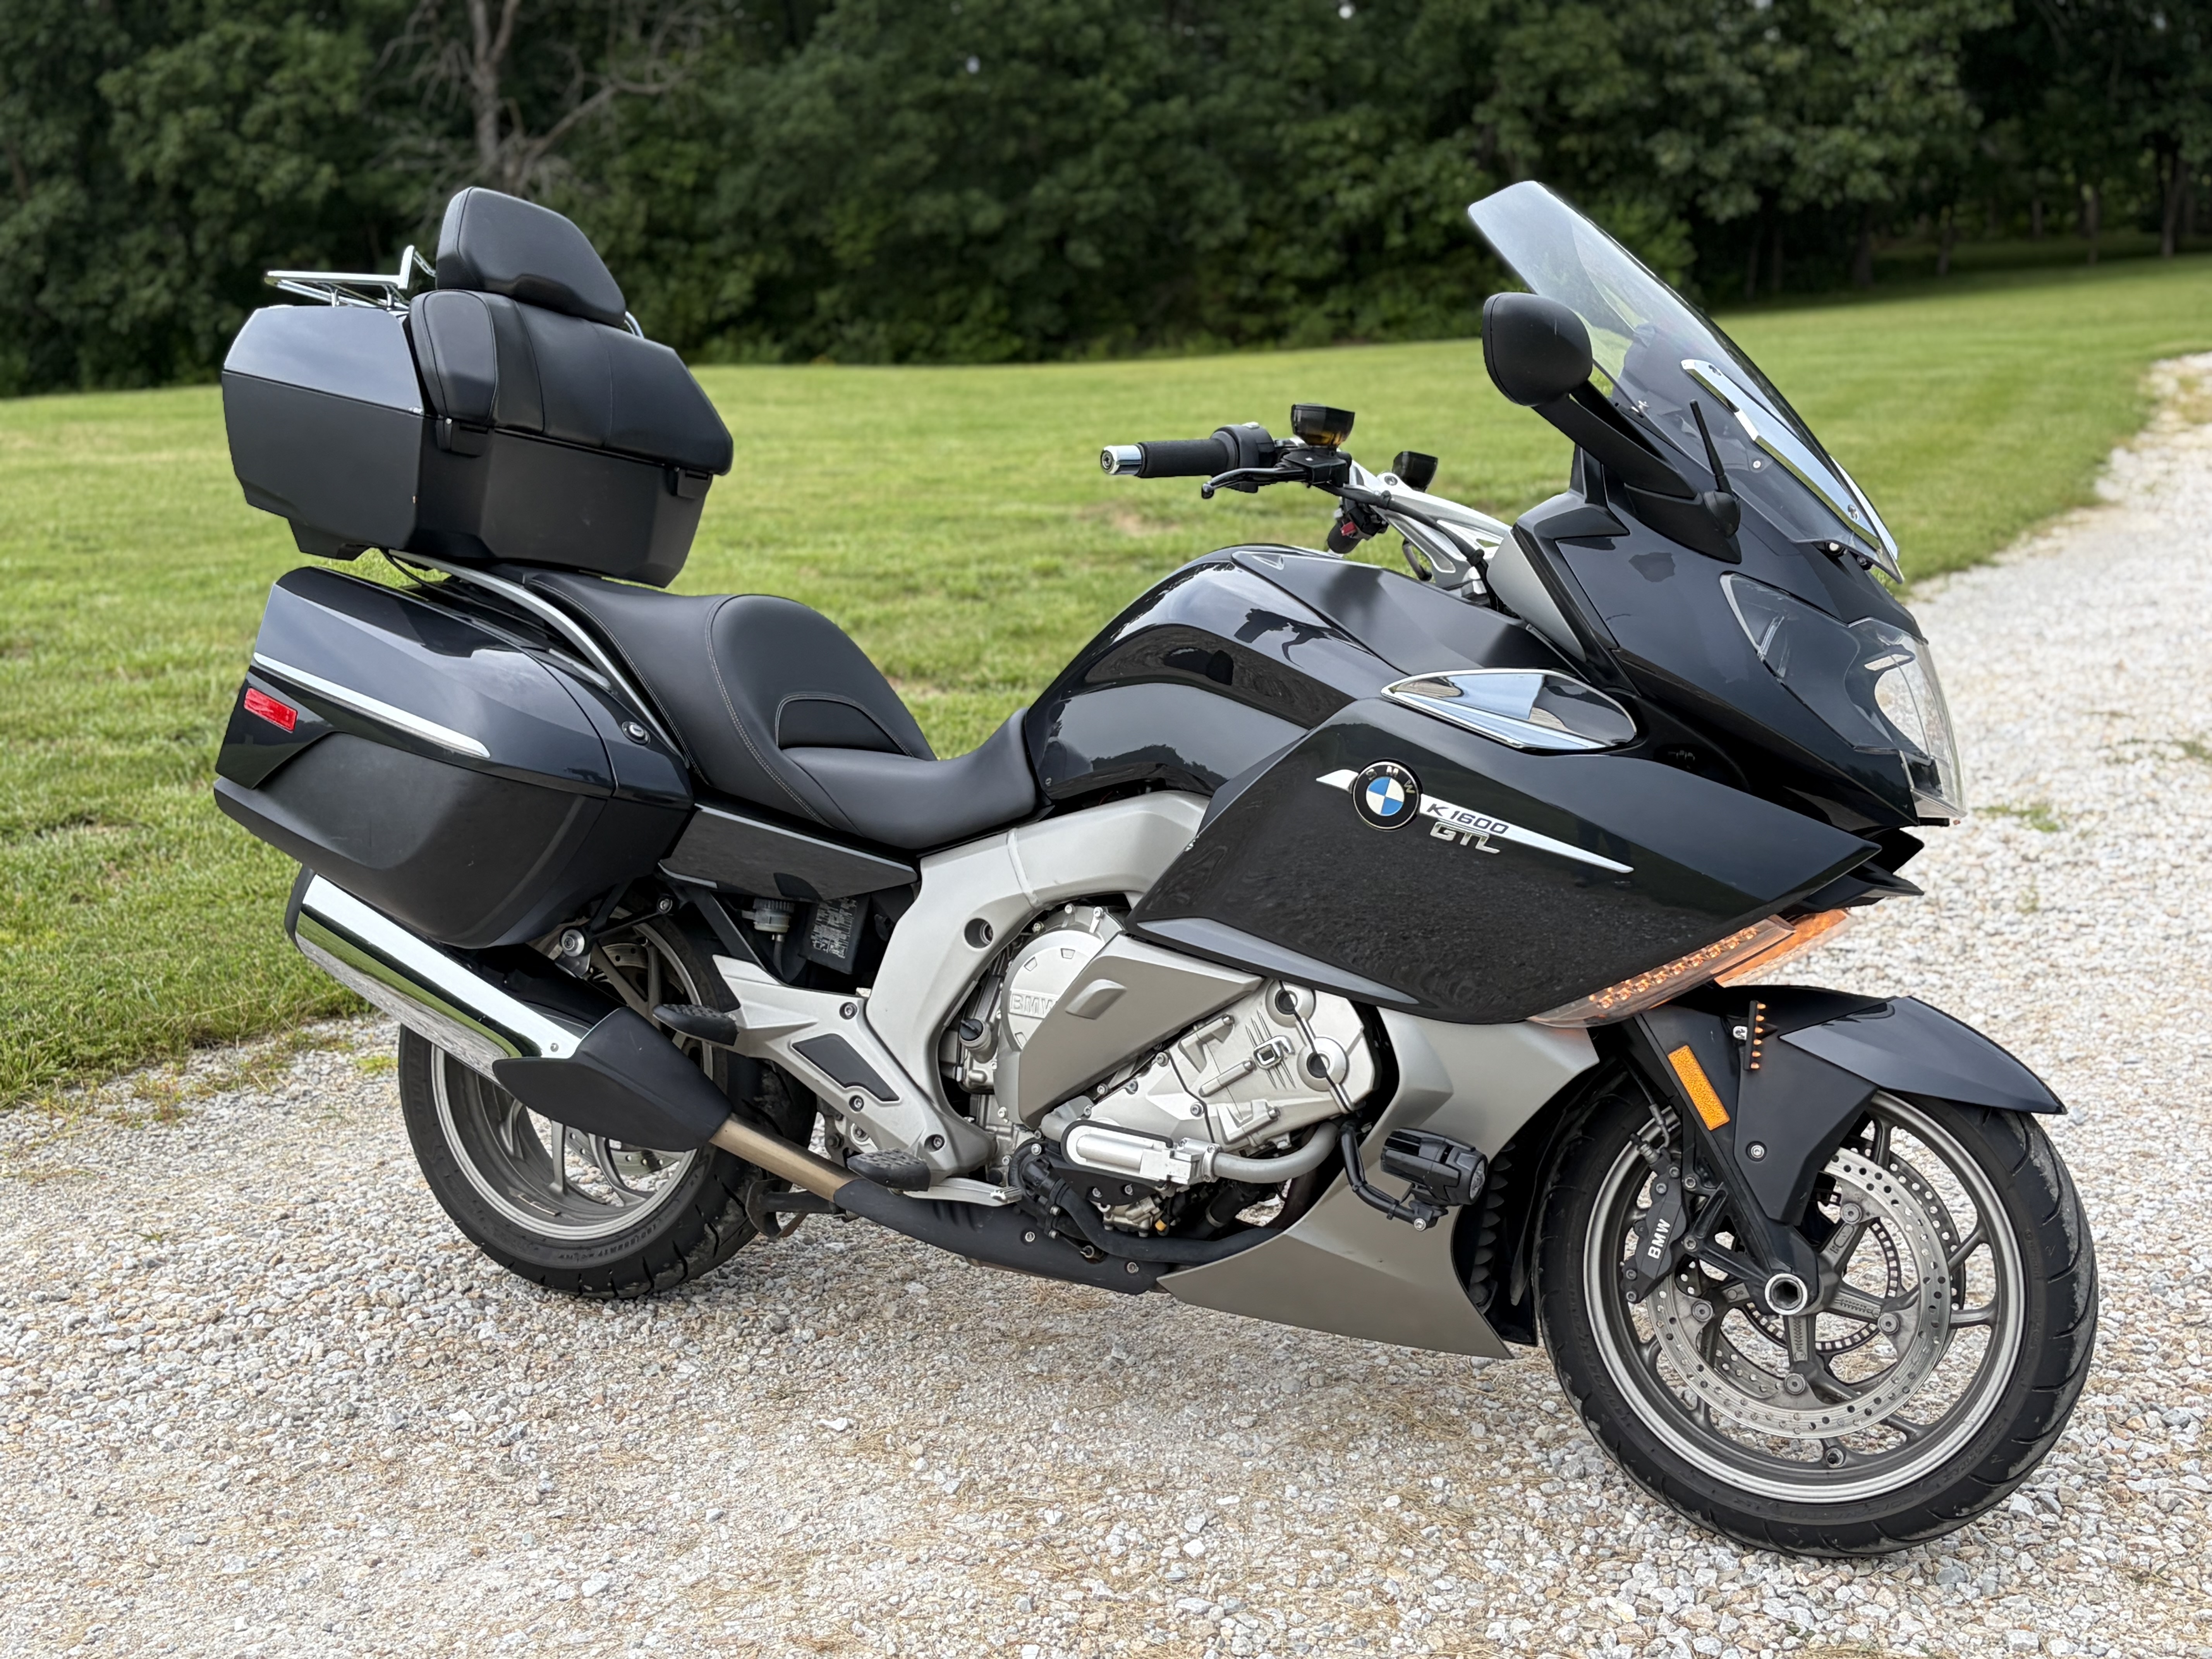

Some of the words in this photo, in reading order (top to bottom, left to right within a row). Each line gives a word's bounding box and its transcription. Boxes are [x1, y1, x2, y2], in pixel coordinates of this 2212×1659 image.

[1365, 766, 1415, 793] BMW
[1426, 803, 1449, 817] K
[1450, 810, 1509, 834] 1600
[1430, 821, 1501, 854] GTL
[1647, 1218, 1671, 1259] BMW
